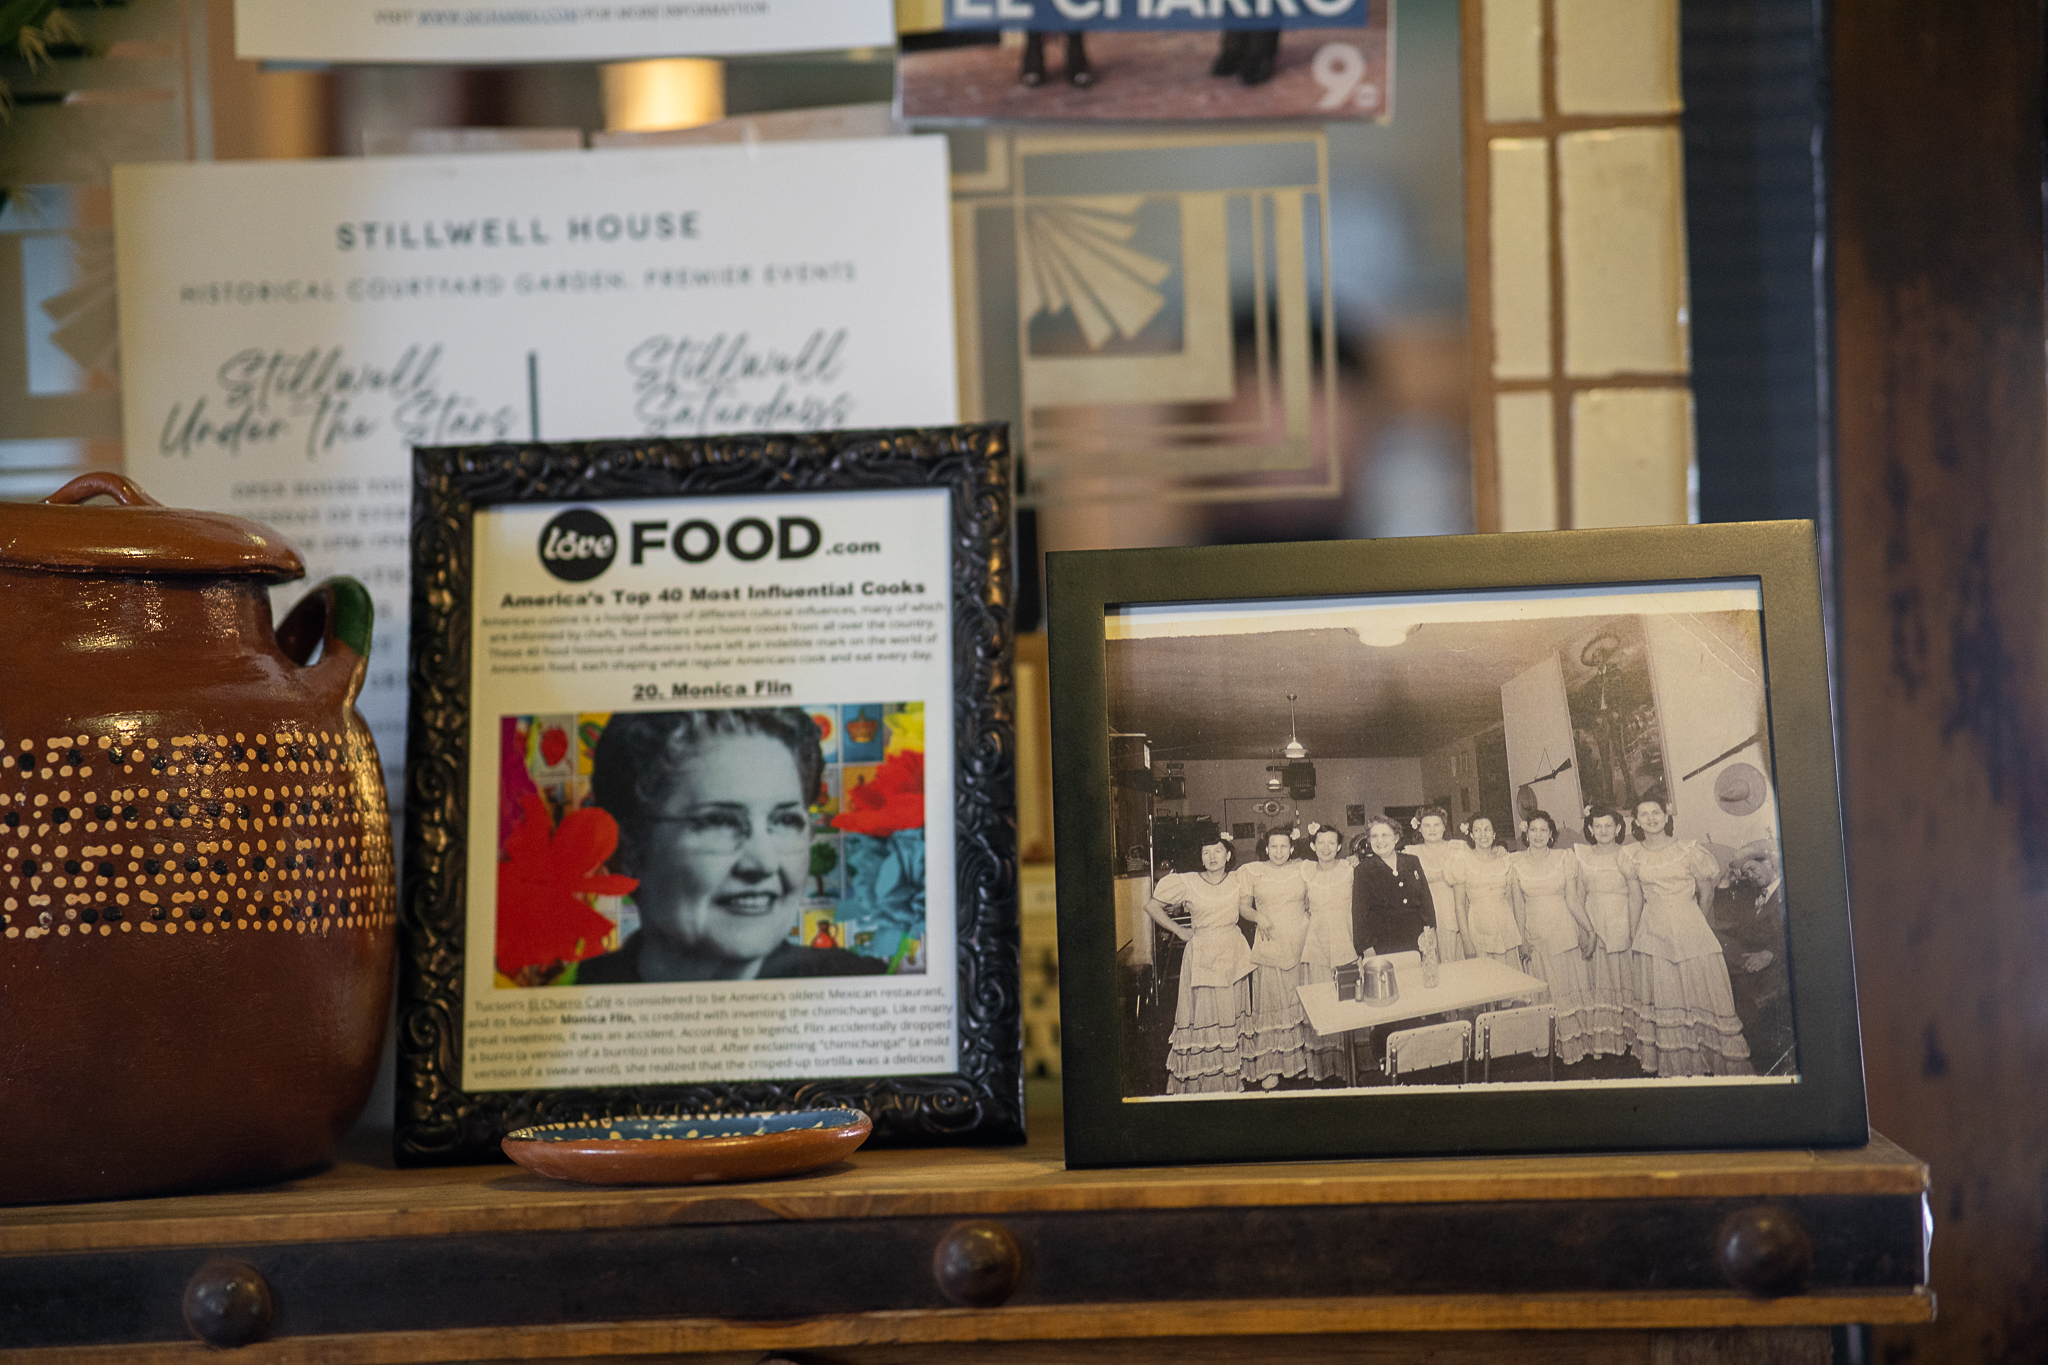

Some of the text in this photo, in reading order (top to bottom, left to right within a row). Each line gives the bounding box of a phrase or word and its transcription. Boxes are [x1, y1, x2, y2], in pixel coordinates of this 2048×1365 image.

[1312, 42, 1366, 108] 9
[336, 211, 700, 251] STILLWELL HOUSE
[179, 279, 337, 305] HISTORICAL
[346, 272, 504, 301] COURTYARD
[643, 264, 752, 291] PREMIER
[761, 259, 857, 287] EVENTS
[624, 326, 848, 391] Stillwell
[216, 342, 444, 412] Stillwell
[160, 395, 286, 458] Under
[392, 390, 520, 447] Stars
[634, 380, 852, 436] Saturdays
[543, 526, 615, 561] love
[500, 579, 926, 609] America's Top 40 Most Influential Cooks
[633, 678, 793, 700] 20. Monica Flin
[466, 1016, 489, 1028] and
[493, 1016, 505, 1028] its
[509, 1014, 556, 1027] founder
[560, 1012, 605, 1025] Monica
[652, 1009, 700, 1022] credited
[704, 1008, 728, 1020] with
[732, 1006, 786, 1022] inventing
[790, 1005, 808, 1017] the
[892, 1002, 916, 1014] Like
[920, 1003, 954, 1016] many
[474, 999, 523, 1012] Tucson's
[542, 997, 581, 1010] Charro
[585, 996, 611, 1008] Café
[628, 993, 692, 1007] considered
[729, 989, 785, 1003] America's
[789, 988, 824, 1001] oldest
[828, 986, 876, 999] Mexican
[466, 1033, 498, 1048] great
[581, 1032, 603, 1042] was
[680, 1025, 738, 1041] According
[803, 1022, 824, 1034] Flin
[828, 1019, 896, 1036] accidentally
[900, 1017, 952, 1034] dropped
[480, 1049, 512, 1062] burro
[531, 1047, 573, 1060] version
[651, 1044, 673, 1056] into
[677, 1043, 696, 1055] hot
[720, 1041, 749, 1053] After
[753, 1038, 816, 1055] exclaiming
[923, 1034, 950, 1046] mild
[473, 1065, 516, 1078] version
[546, 1066, 580, 1076] swear
[624, 1061, 645, 1073] she
[649, 1059, 695, 1072] realized
[699, 1058, 722, 1071] that
[726, 1058, 744, 1070] the
[748, 1055, 810, 1072] crisped-up
[814, 1054, 852, 1067] tortilla
[856, 1056, 878, 1065] was
[893, 1051, 946, 1064] delicious
